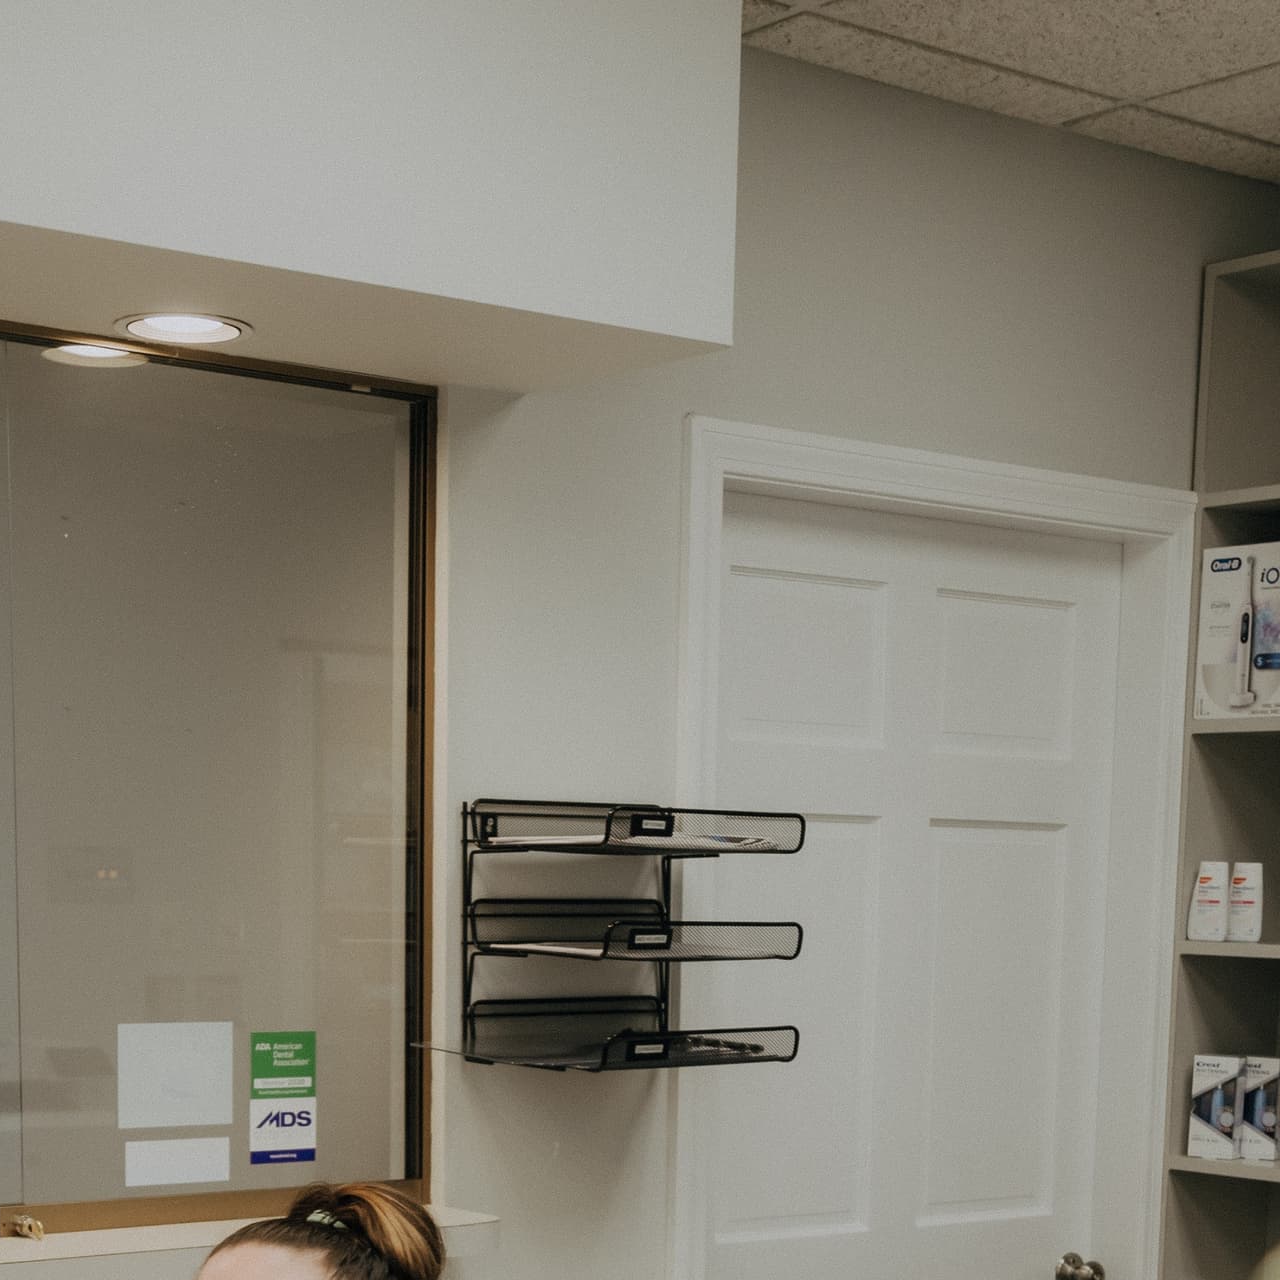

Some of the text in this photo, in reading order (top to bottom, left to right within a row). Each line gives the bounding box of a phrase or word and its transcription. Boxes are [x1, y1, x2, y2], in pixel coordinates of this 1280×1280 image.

[1212, 558, 1241, 571] Oral-B
[1260, 567, 1280, 584] iO
[272, 1042, 303, 1050] American
[272, 1050, 294, 1058] Dental
[256, 1110, 312, 1129] MDS
